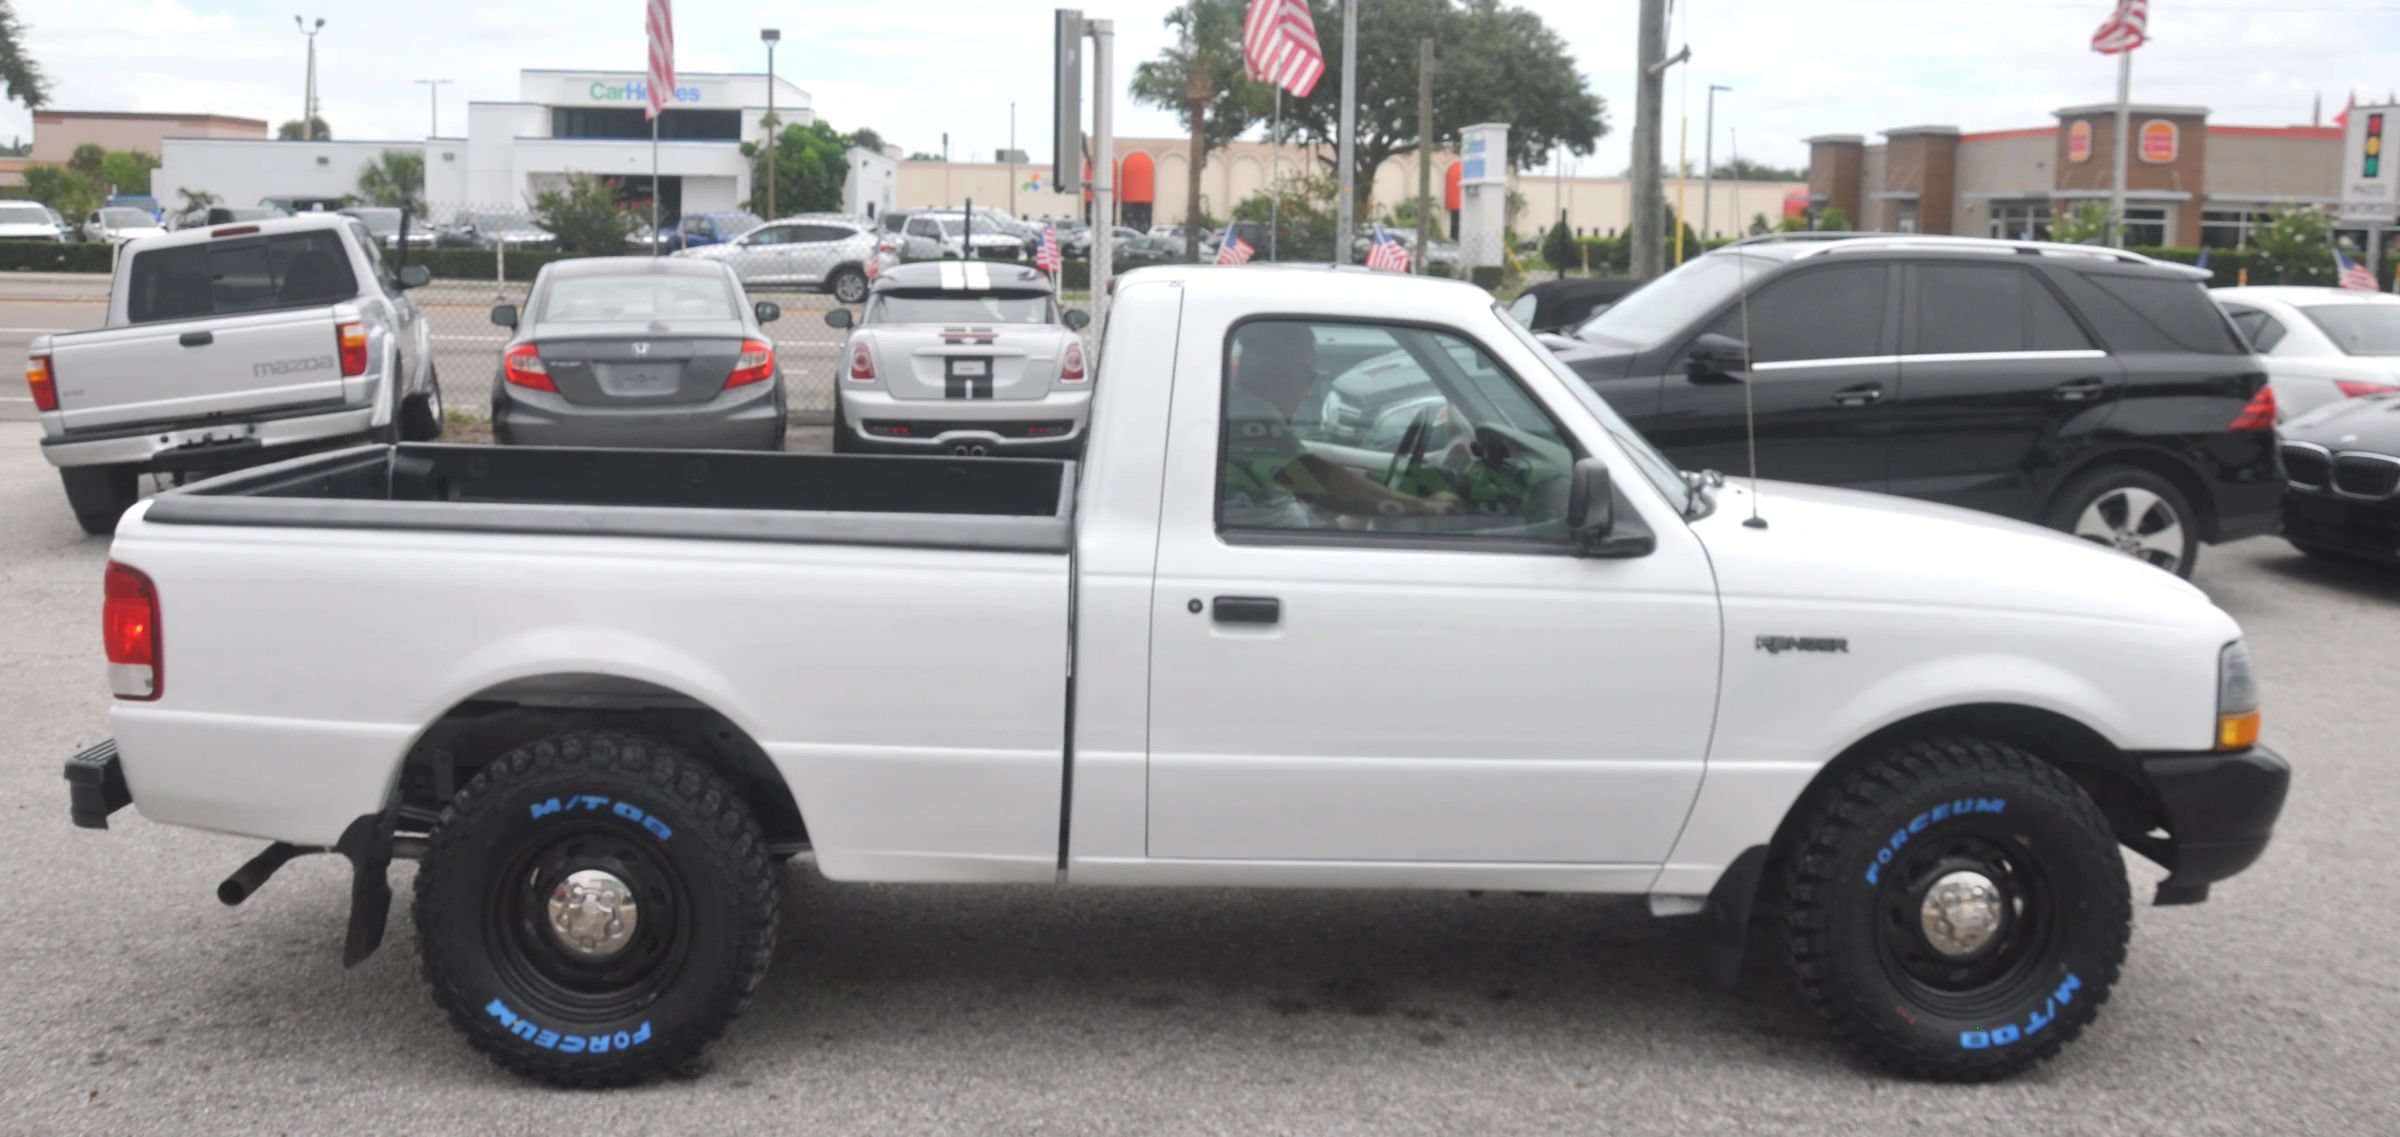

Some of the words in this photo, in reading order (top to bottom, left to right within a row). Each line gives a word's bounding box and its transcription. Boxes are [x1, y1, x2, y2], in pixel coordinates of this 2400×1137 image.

[588, 81, 702, 102] CarHes
[252, 355, 335, 378] mazda
[1865, 798, 2006, 886] FORCEUM
[484, 997, 652, 1053] FORCEUM
